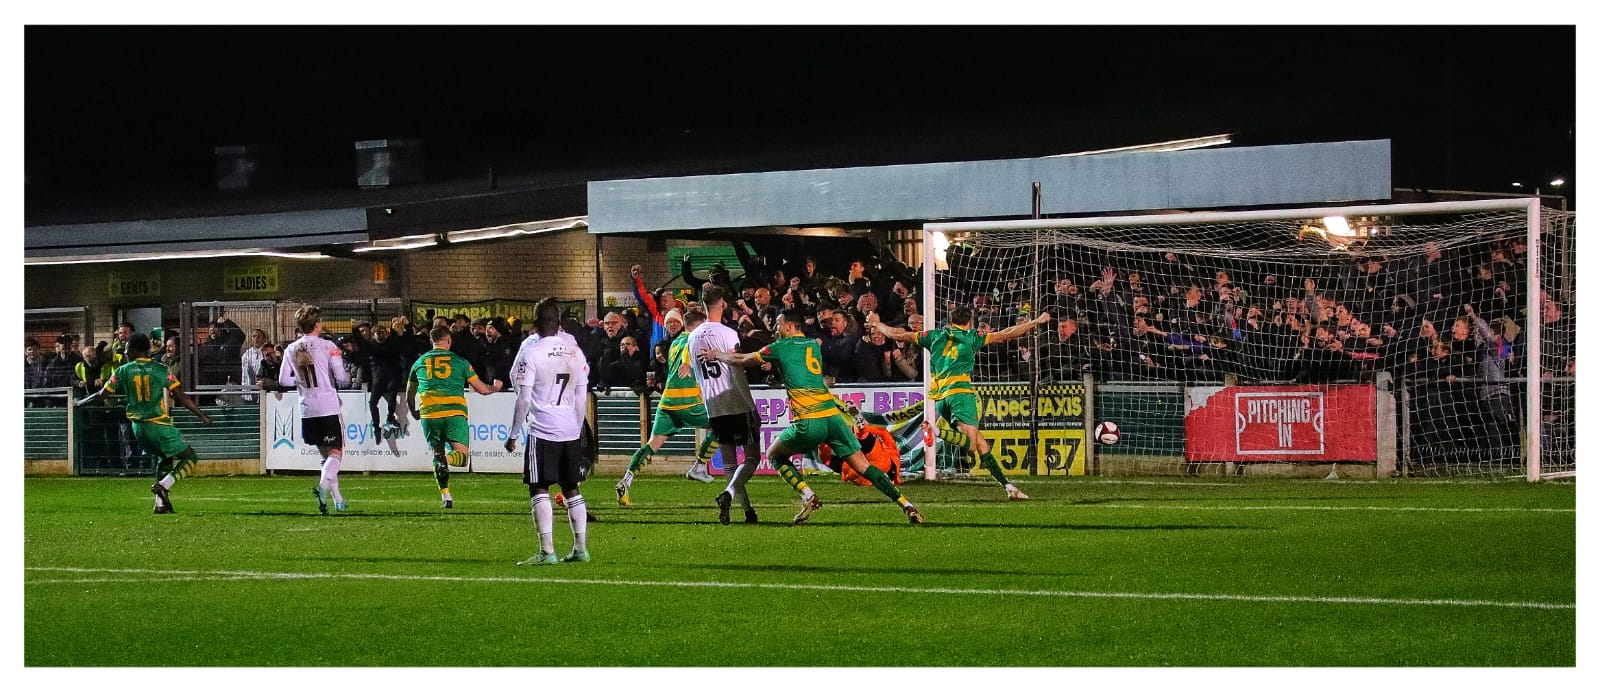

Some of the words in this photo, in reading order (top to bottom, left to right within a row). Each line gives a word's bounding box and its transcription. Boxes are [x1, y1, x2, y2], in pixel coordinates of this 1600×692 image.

[121, 280, 149, 294] GENTS
[235, 276, 267, 290] LADIES
[423, 356, 452, 380] 15
[697, 355, 722, 380] 15
[805, 347, 822, 375] 6
[133, 374, 151, 402] 11
[299, 364, 318, 388] 11
[555, 373, 570, 407] 7
[984, 397, 1031, 421] Apec
[1248, 398, 1311, 423] PITCHING
[1278, 423, 1293, 448] IN
[1044, 438, 1082, 469] 57
